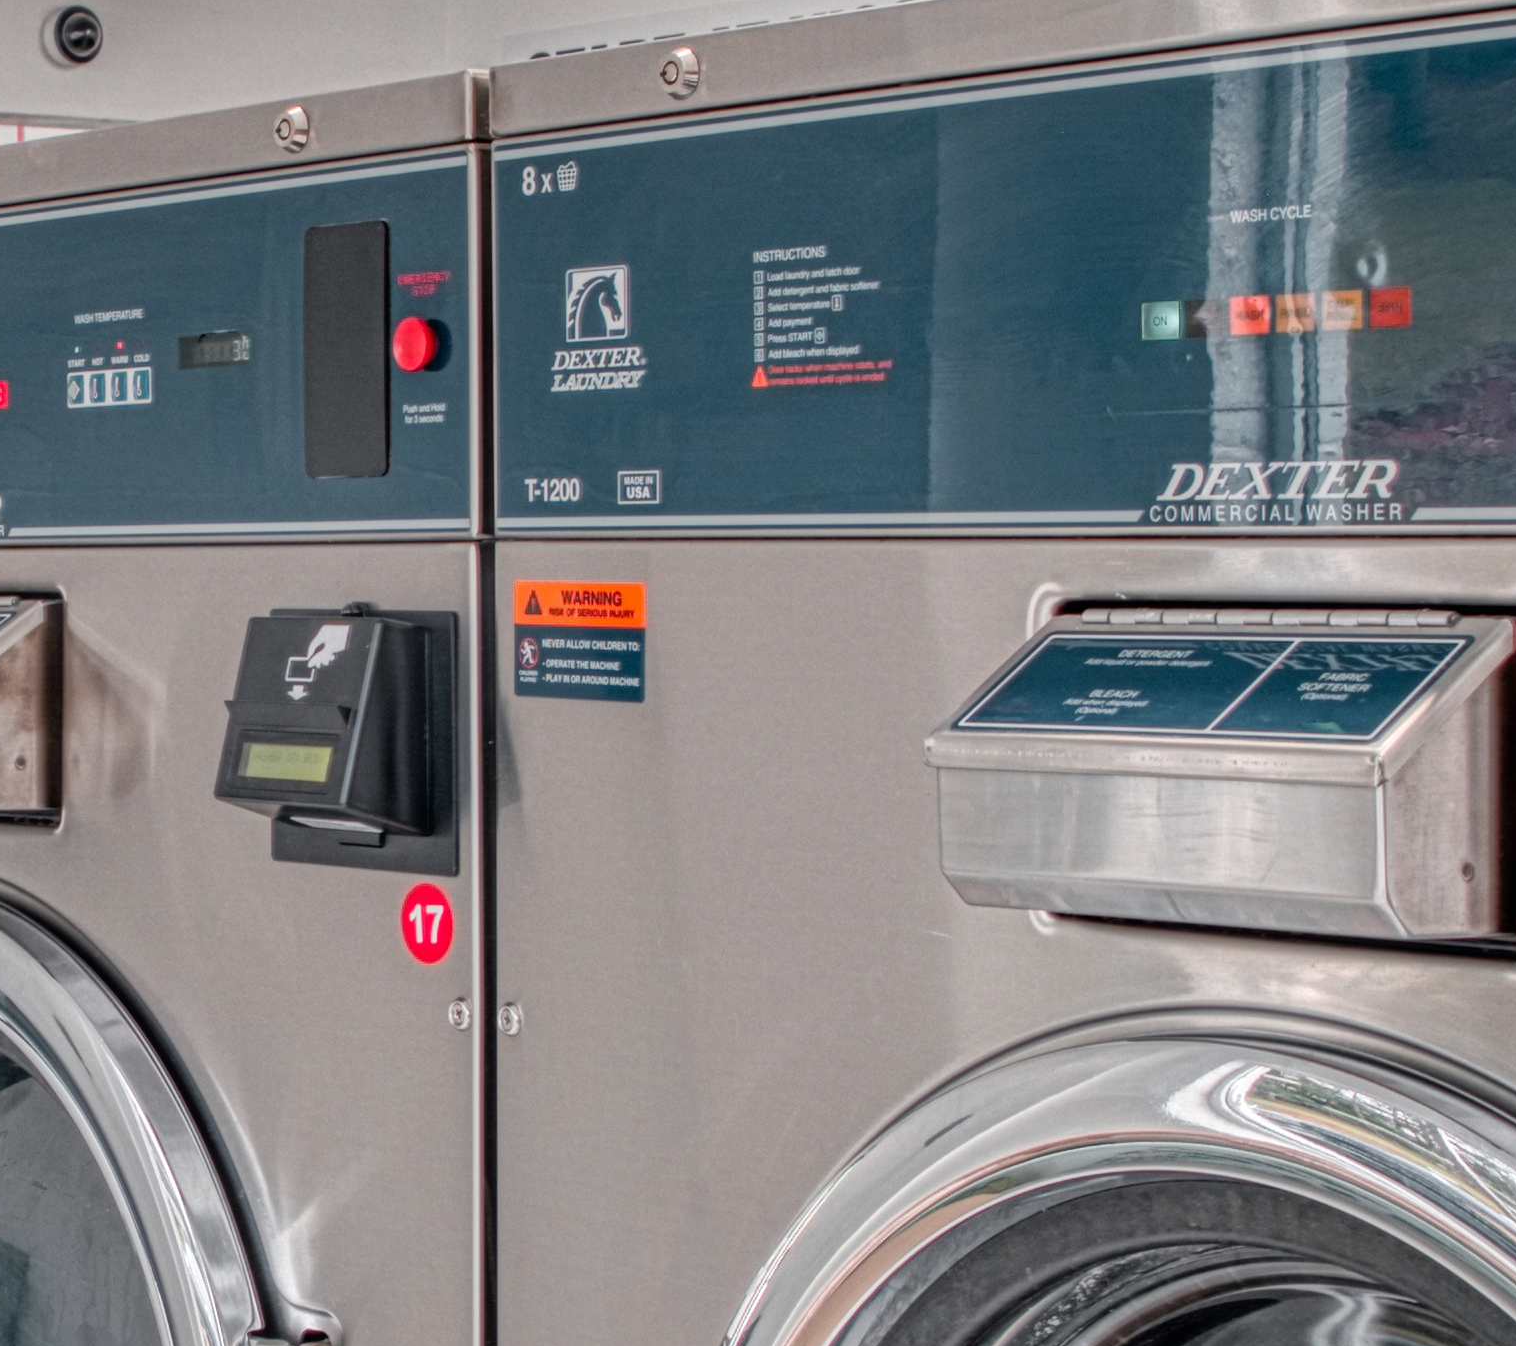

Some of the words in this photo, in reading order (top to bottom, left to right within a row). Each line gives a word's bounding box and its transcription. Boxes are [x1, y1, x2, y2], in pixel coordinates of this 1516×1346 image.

[522, 166, 536, 196] 8
[1230, 209, 1267, 223] WASH
[1270, 205, 1312, 220] CYCLE
[753, 245, 827, 263] INSTRUCTIONS
[75, 314, 94, 324] WASH
[95, 309, 143, 322] TEMPERATURE
[1153, 316, 1168, 326] ON
[788, 332, 813, 342] START
[68, 359, 84, 367] START
[92, 357, 103, 366] HOT
[134, 354, 149, 363] COLD
[551, 347, 641, 371] DEXTER
[551, 370, 646, 392] LAUNDRY
[624, 476, 642, 486] MADE
[645, 476, 653, 484] IN
[1156, 459, 1398, 501] DEXTER
[525, 479, 580, 502] T-1200
[627, 486, 650, 499] USA
[1149, 505, 1294, 523] COMMERCIAL
[1306, 503, 1402, 521] WASHER
[561, 590, 622, 606] WARNING
[542, 639, 566, 649] NEVER
[567, 640, 590, 649] ALLOW
[592, 640, 627, 650] CHILDREN
[628, 642, 640, 651] TO:
[1118, 650, 1194, 658] DETERGENT
[546, 659, 575, 669] OPERATE
[577, 660, 588, 669] THE
[590, 661, 619, 671] MACHINE
[546, 674, 562, 683] PLAY
[564, 675, 570, 683] IN
[571, 675, 580, 684] OR
[582, 676, 608, 685] AROUND
[610, 677, 639, 687] MACHINE
[1318, 673, 1369, 681] FABRIC
[1088, 690, 1140, 698] BLEACH
[1297, 683, 1371, 692] SOFTENER
[410, 904, 443, 943] 17
